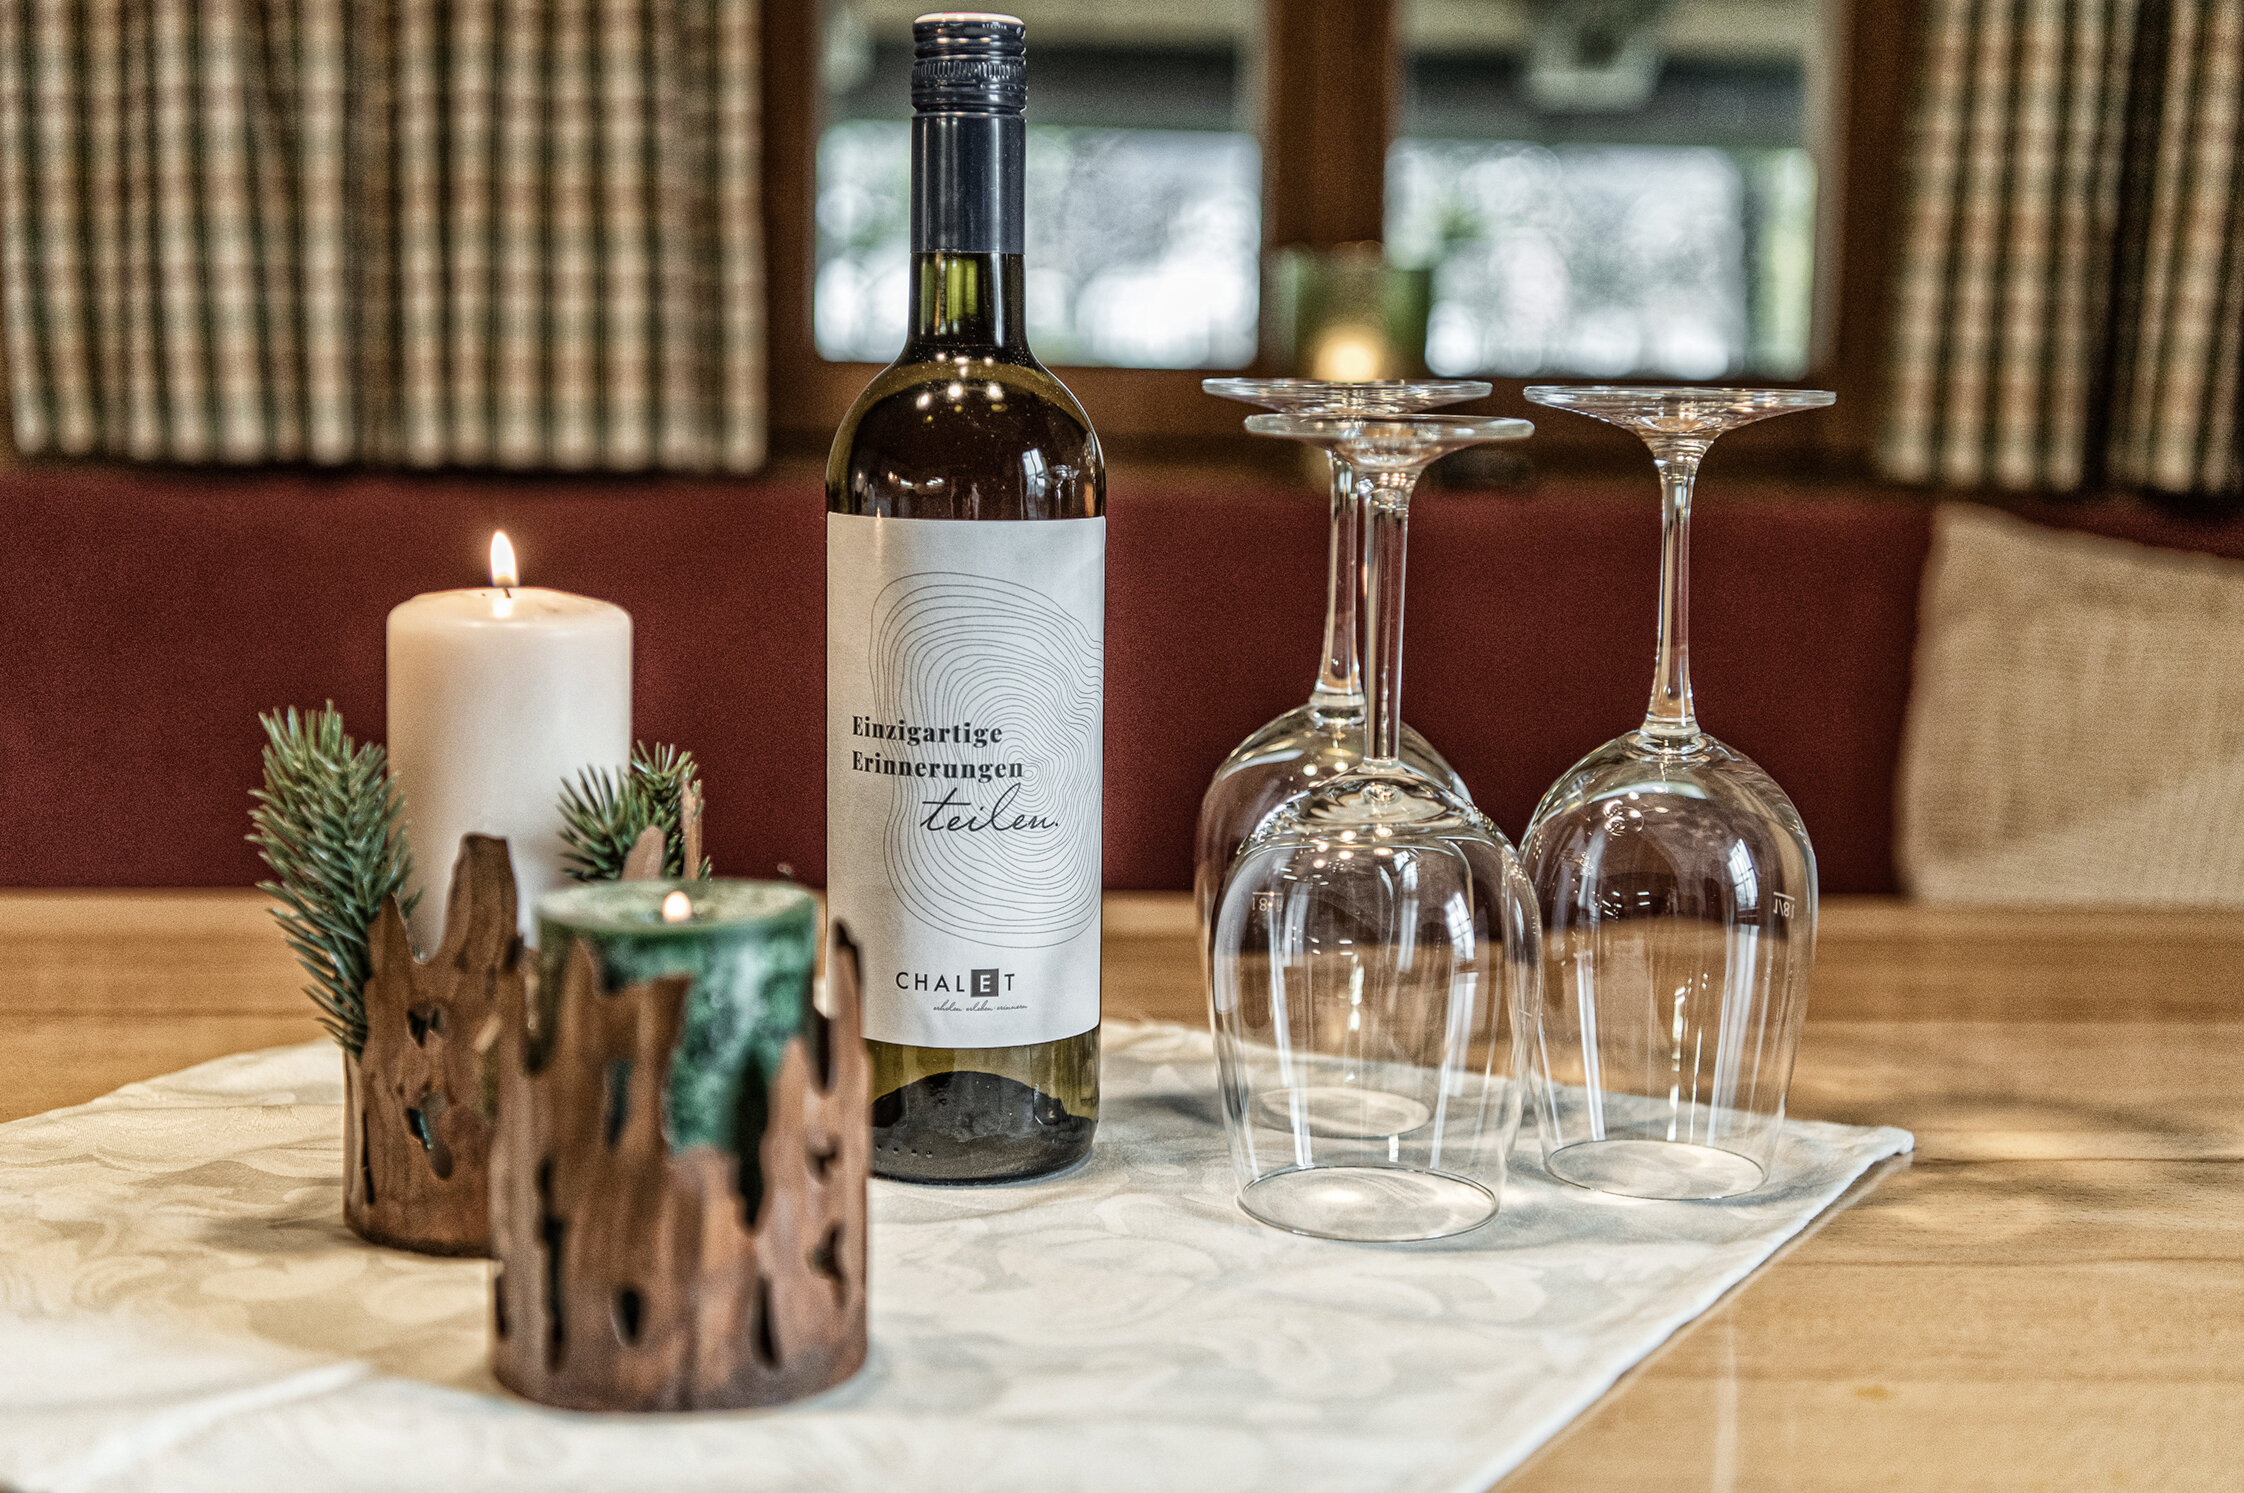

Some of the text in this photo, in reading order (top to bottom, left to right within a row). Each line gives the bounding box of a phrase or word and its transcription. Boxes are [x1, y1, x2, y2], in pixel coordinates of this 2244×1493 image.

[852, 715, 1003, 748] Einzigartige
[852, 751, 1023, 783] Erinnerungen
[920, 782, 1059, 832] teilen.
[895, 970, 1016, 994] CHALET
